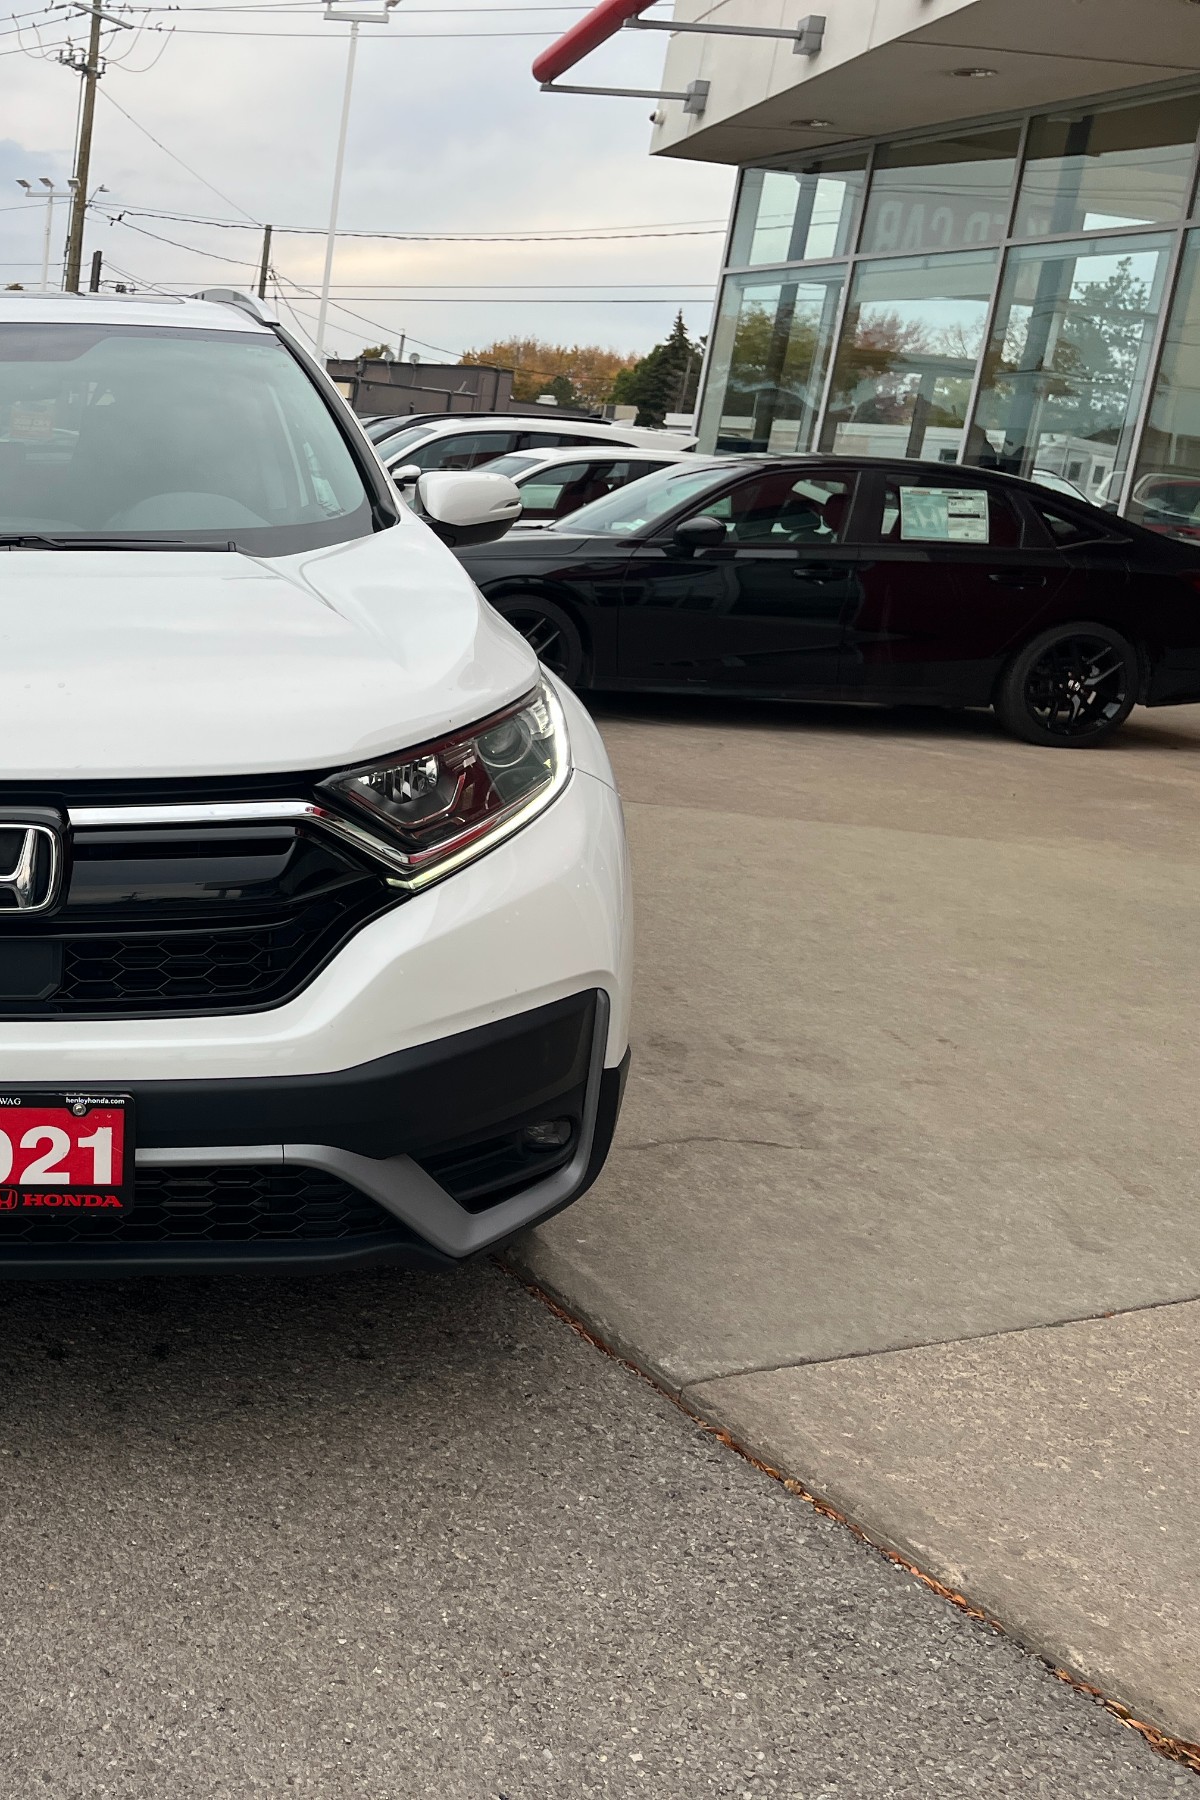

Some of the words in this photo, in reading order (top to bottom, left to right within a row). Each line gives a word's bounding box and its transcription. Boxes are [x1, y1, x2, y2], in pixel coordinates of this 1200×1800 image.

[0, 1097, 21, 1105] WAG
[65, 1097, 125, 1105] henleyhonda.com
[22, 1194, 123, 1207] HONDA
